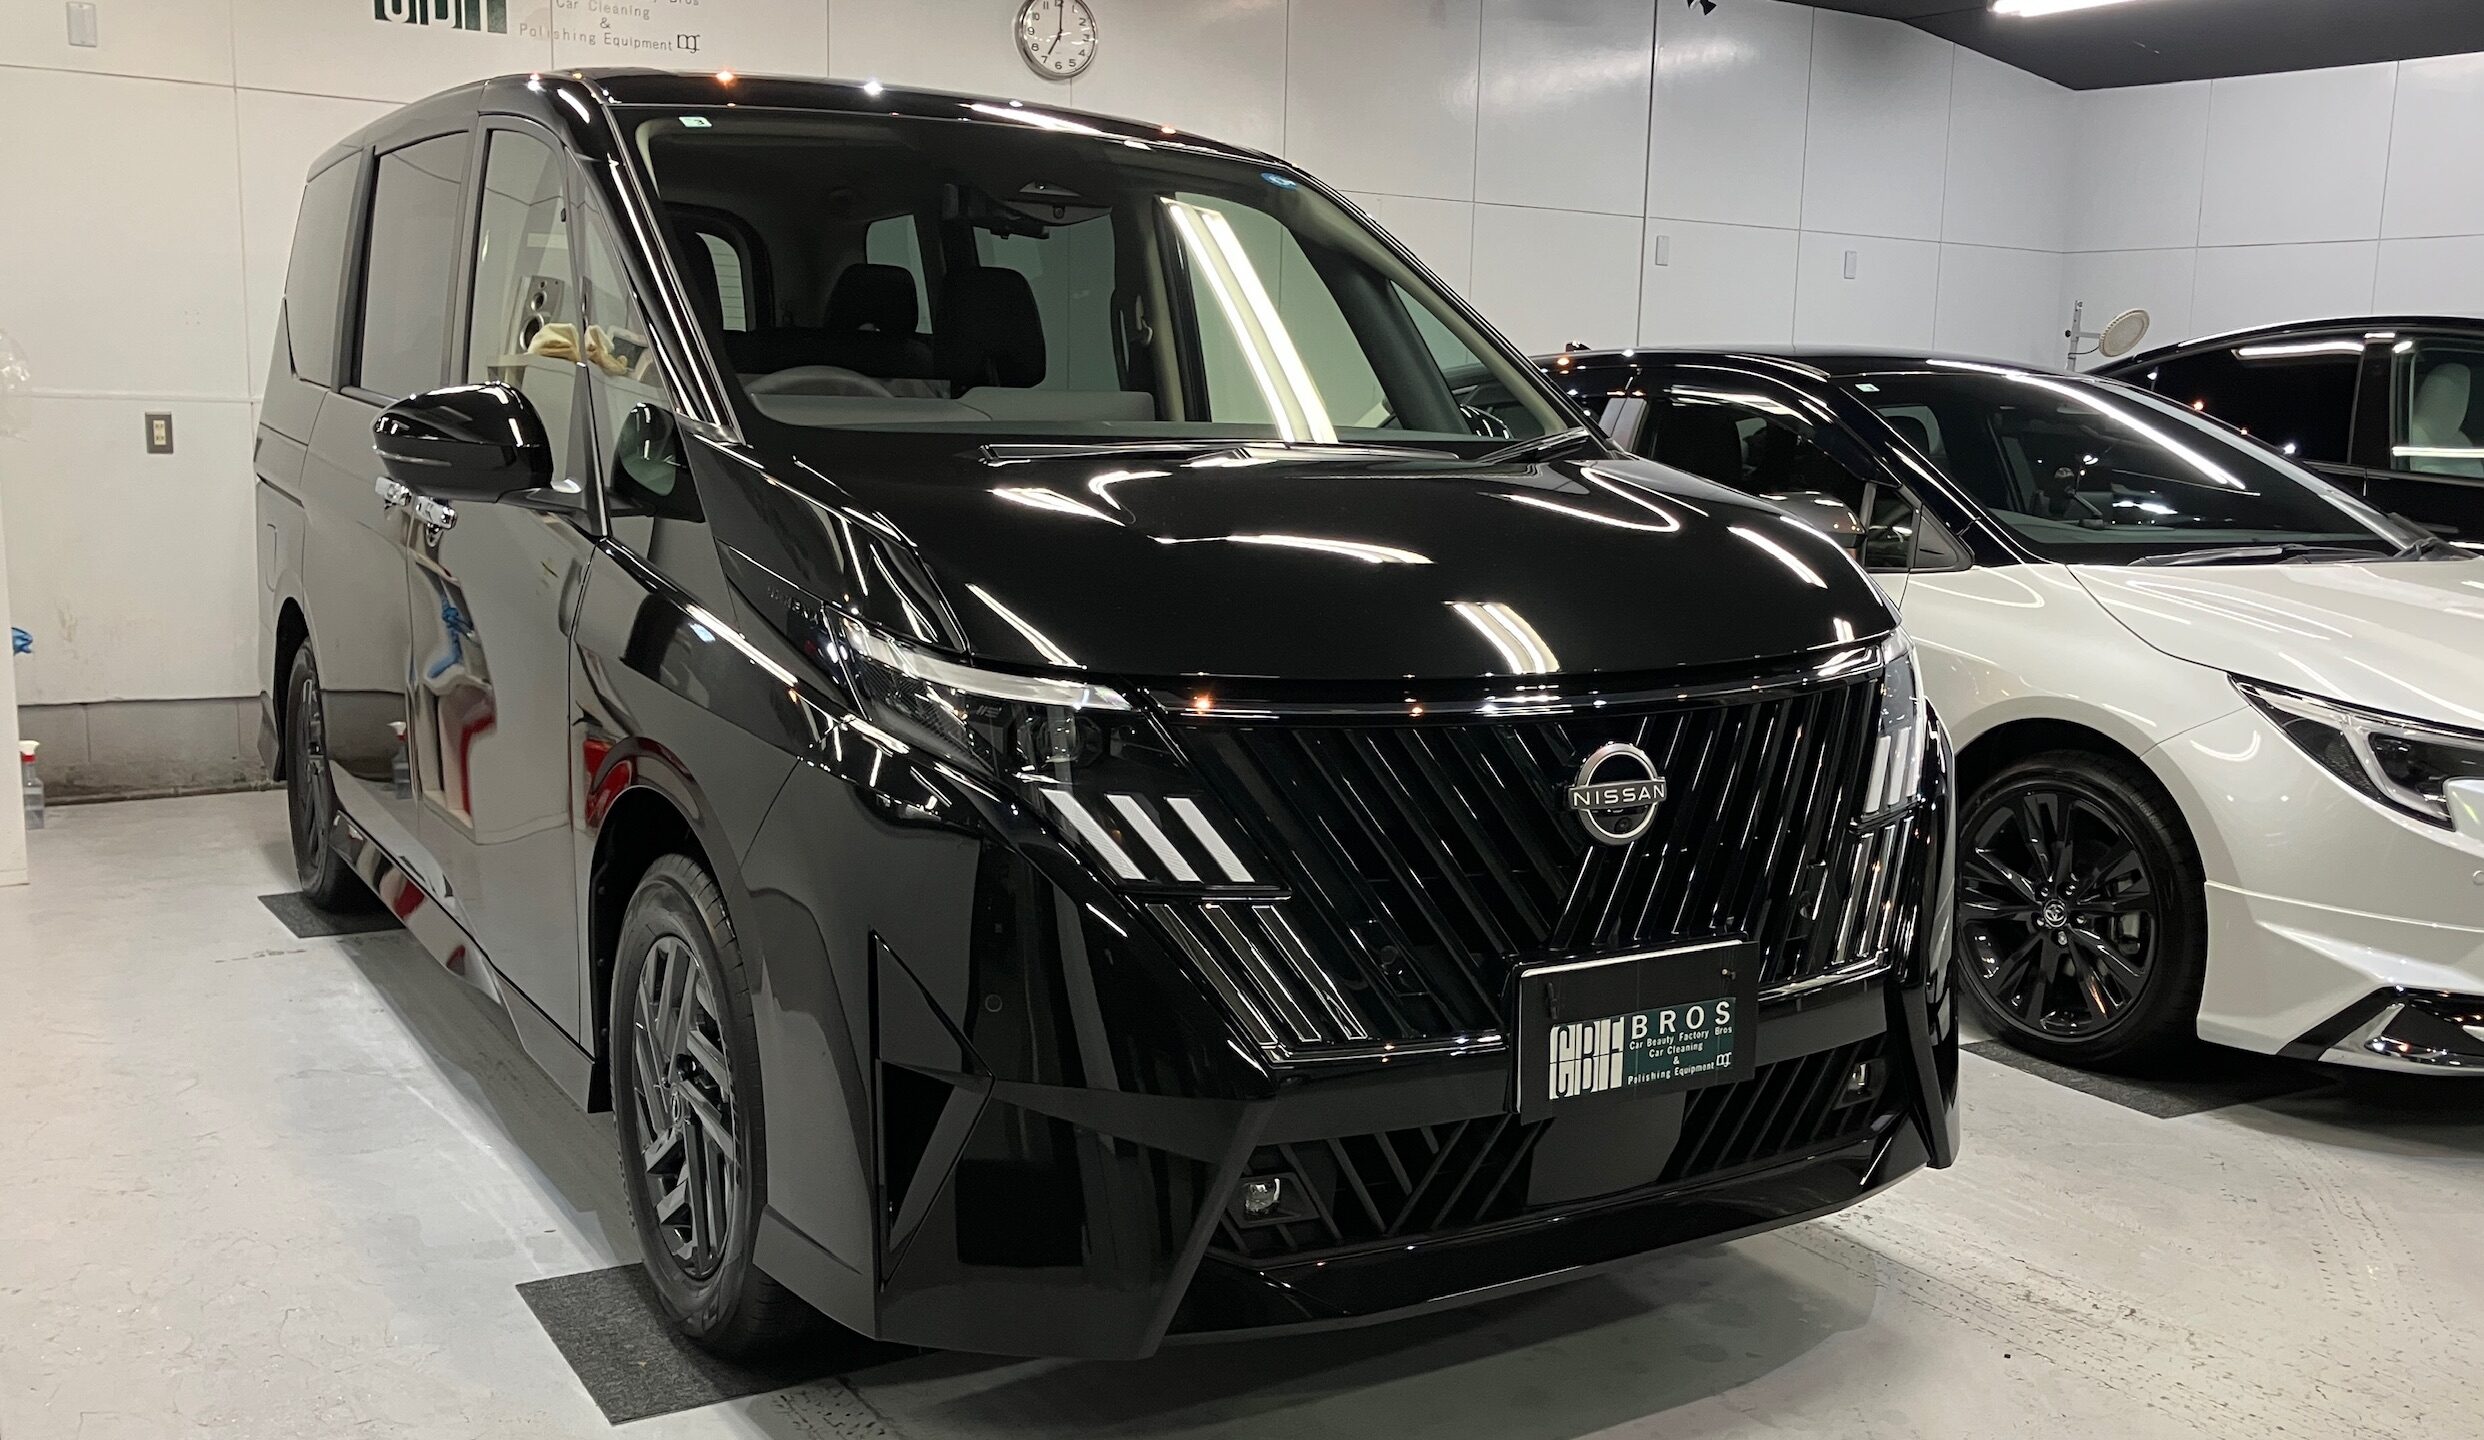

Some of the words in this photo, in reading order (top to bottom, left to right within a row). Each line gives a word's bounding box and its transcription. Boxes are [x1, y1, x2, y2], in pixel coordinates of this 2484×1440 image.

[588, 0, 651, 20] Cleaning
[599, 17, 611, 29] &
[1079, 18, 1086, 27] 2
[1027, 26, 1035, 36] 9
[519, 23, 597, 46] Polishing
[603, 32, 673, 51] Equipment
[1031, 43, 1039, 52] 8
[1078, 49, 1085, 57] 4
[1041, 55, 1048, 64] 7
[1069, 59, 1076, 68] 5
[1055, 61, 1062, 70] 6
[1573, 784, 1665, 807] NISSAN
[1631, 1001, 1731, 1040] BROS
[1629, 1041, 1643, 1050] Car
[1646, 1035, 1674, 1047] Beauty
[1679, 1030, 1710, 1042] Factory
[1714, 1026, 1732, 1036] Bros
[1648, 1049, 1664, 1058] Car
[1667, 1042, 1703, 1055] Cleaning
[1673, 1056, 1680, 1065] &
[1627, 1070, 1671, 1085] Polishing
[1674, 1062, 1715, 1076] Equipment
